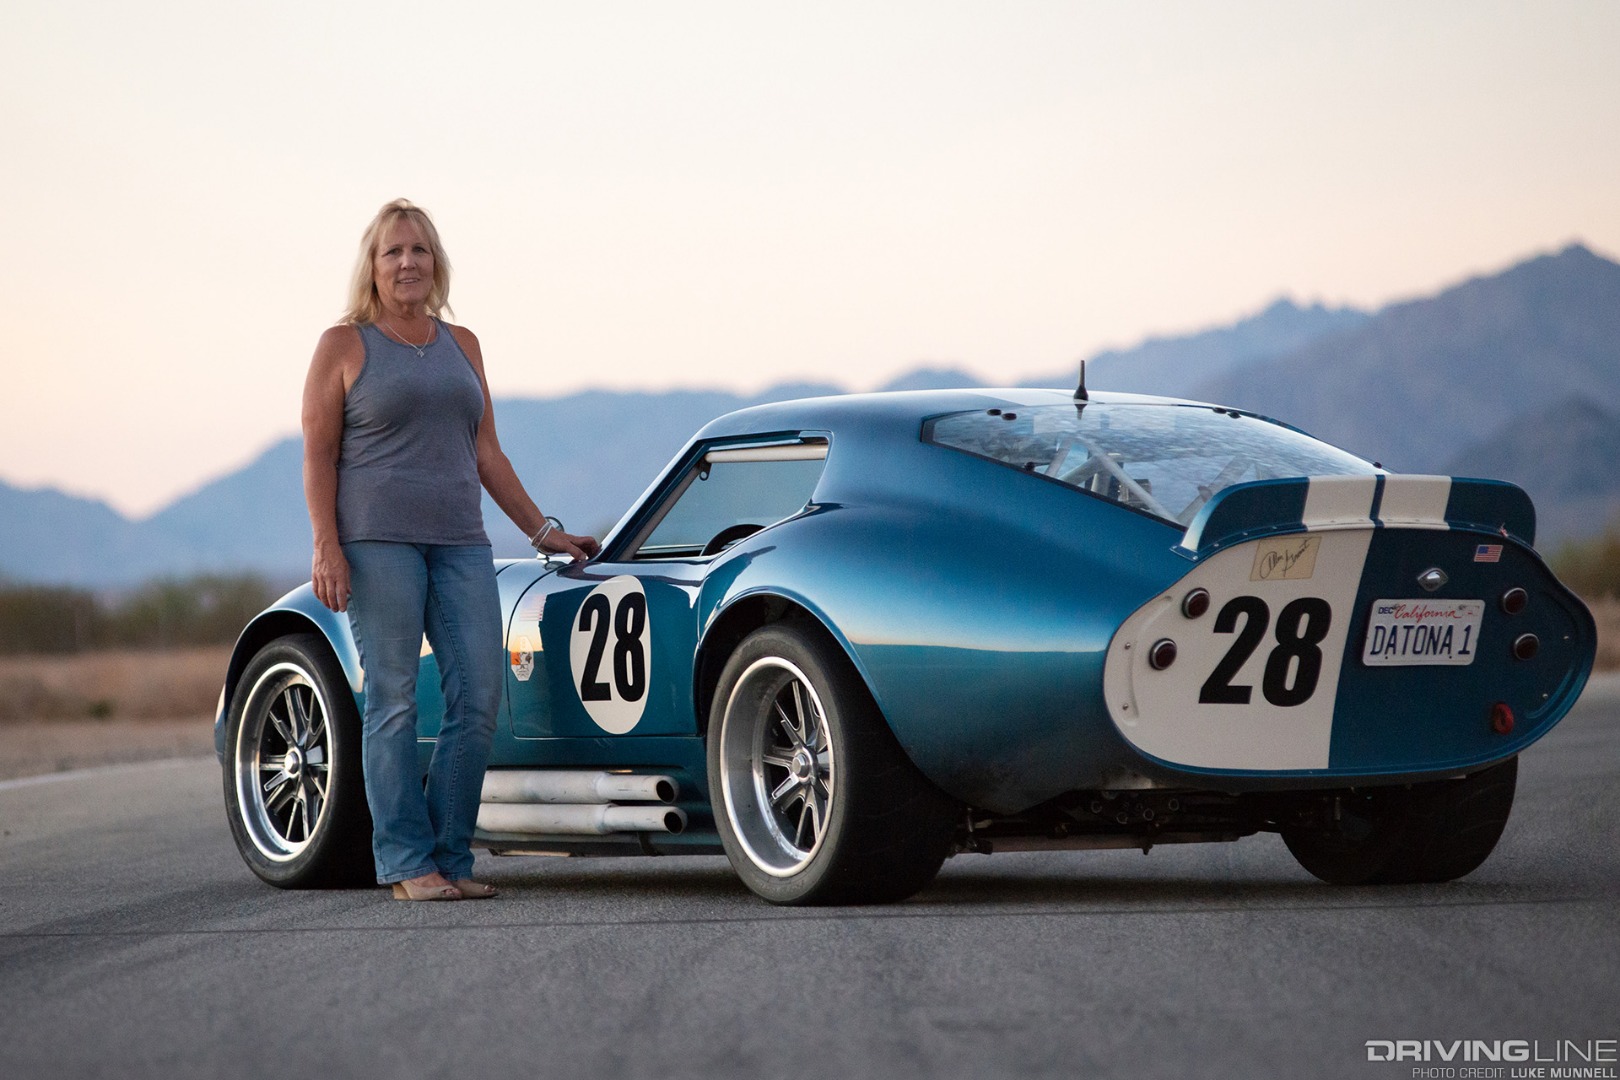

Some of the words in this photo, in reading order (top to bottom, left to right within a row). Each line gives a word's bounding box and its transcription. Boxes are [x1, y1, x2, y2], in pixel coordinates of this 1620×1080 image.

[1378, 606, 1394, 615] DEC
[1394, 604, 1462, 623] California
[578, 592, 646, 702] 28
[1198, 595, 1332, 707] 28
[1370, 625, 1454, 655] DATONA
[1458, 624, 1472, 655] 1
